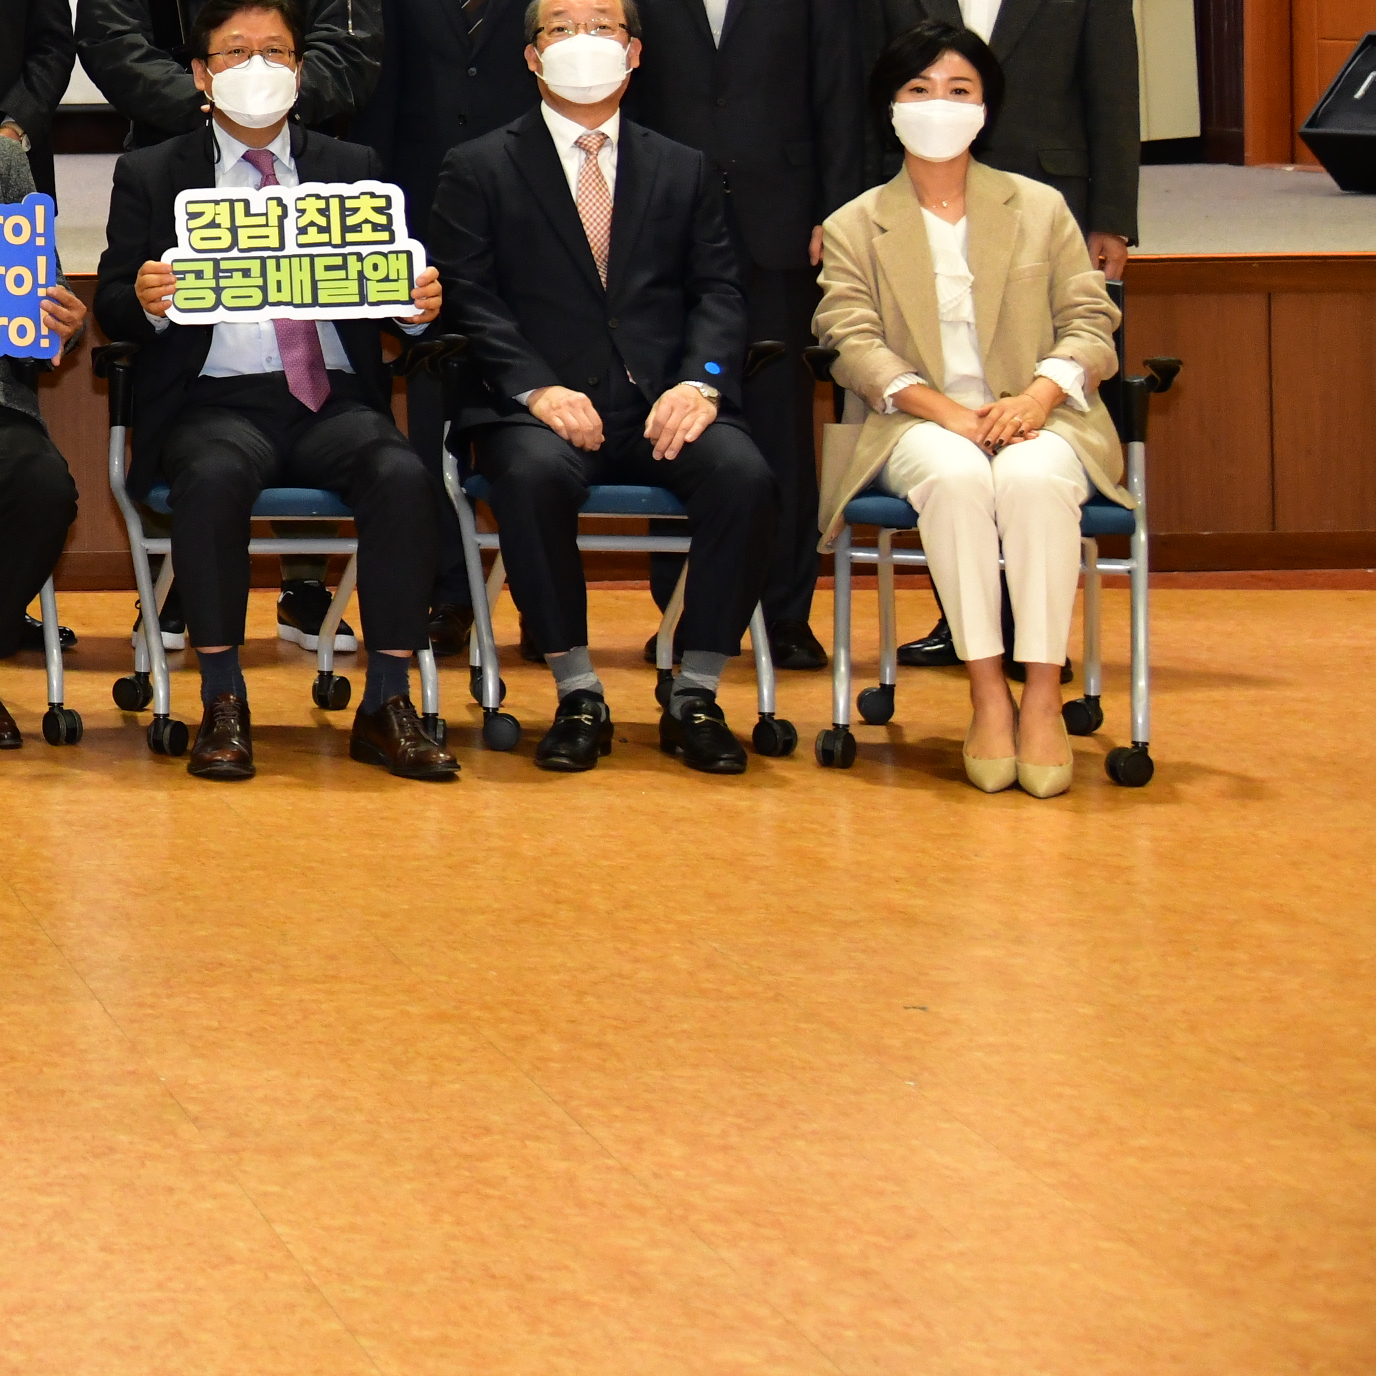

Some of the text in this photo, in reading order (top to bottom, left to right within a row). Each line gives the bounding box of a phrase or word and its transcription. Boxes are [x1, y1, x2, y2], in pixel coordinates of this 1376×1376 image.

[186, 192, 395, 253] 경남 최초
[172, 250, 413, 313] 공공배달앱
